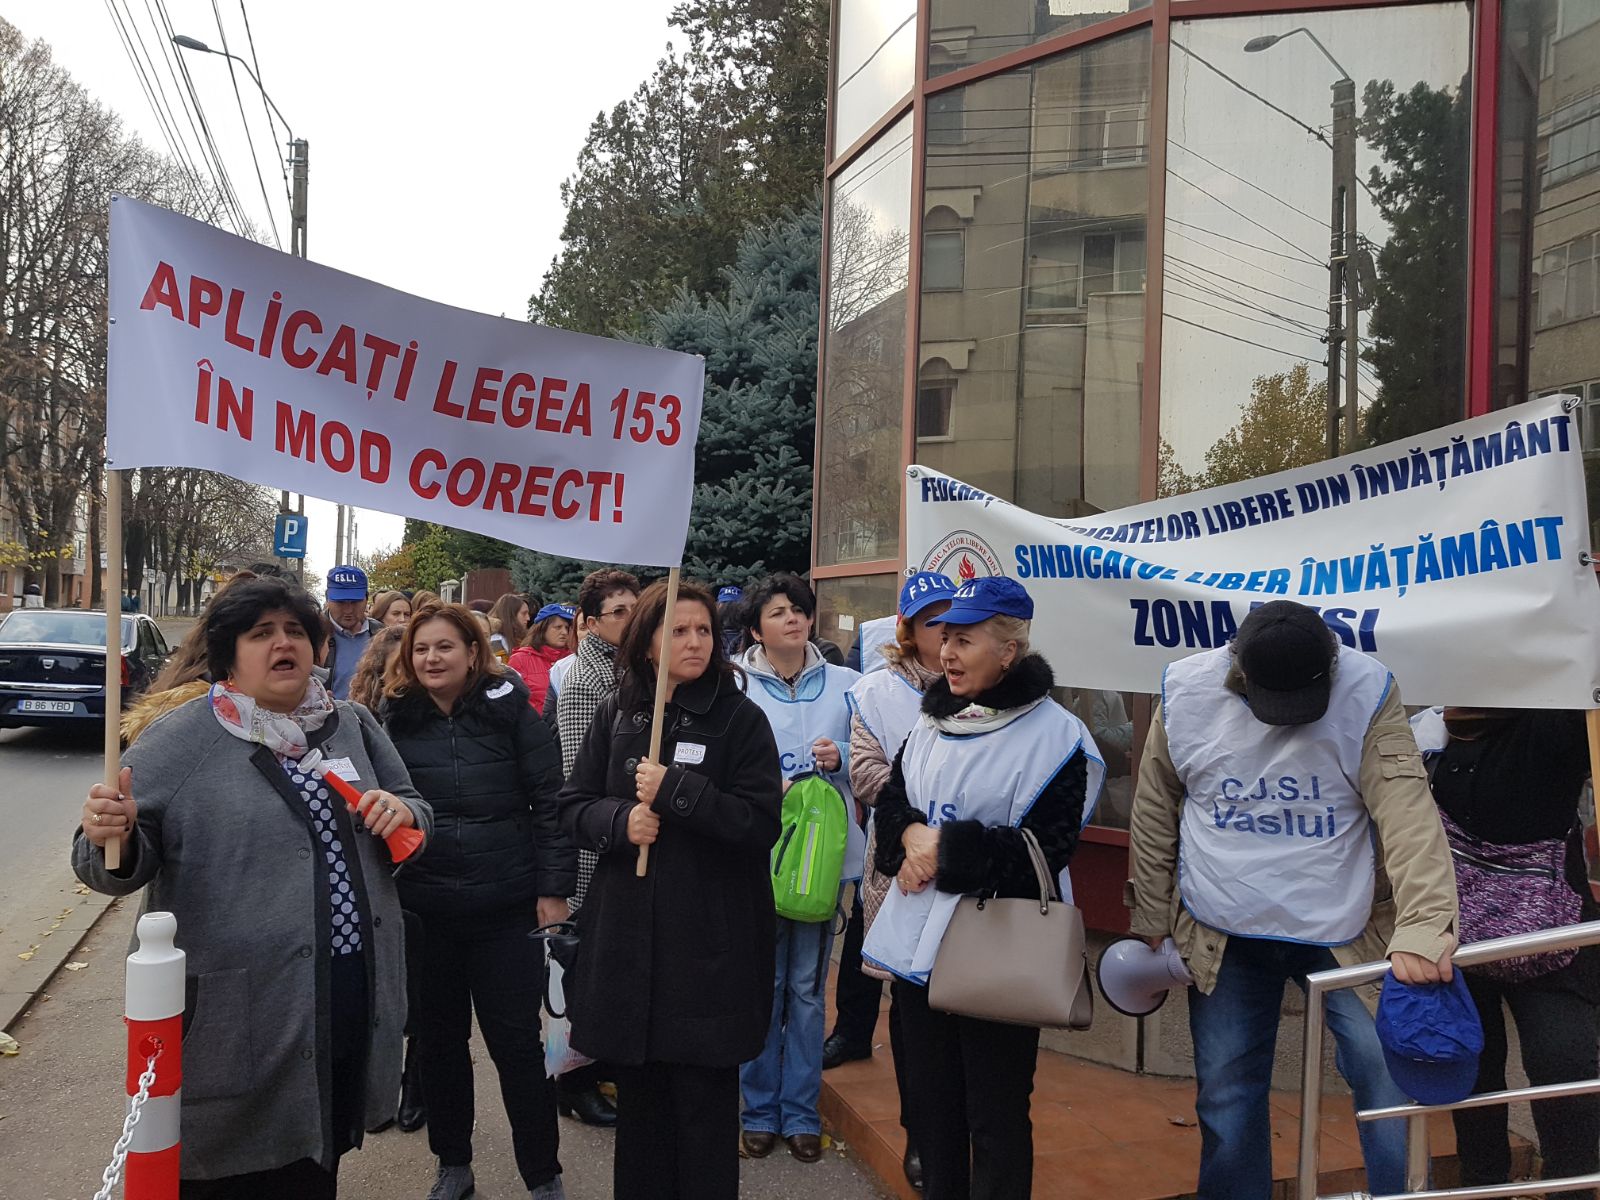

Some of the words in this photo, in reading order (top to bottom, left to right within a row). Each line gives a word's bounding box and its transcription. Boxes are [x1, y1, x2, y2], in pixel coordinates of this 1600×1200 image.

[433, 360, 592, 437] LEGEA
[611, 388, 682, 446] 153
[194, 358, 255, 441] ÎN
[275, 401, 392, 484] MOD
[409, 448, 625, 524] CORECT!
[1202, 488, 1295, 536] LIBERE
[1296, 473, 1350, 515] DIN
[1350, 415, 1571, 501] ÎNVĂȚĂMÂNT
[284, 519, 299, 544] P
[1015, 544, 1179, 580] SINDICATUL
[1184, 567, 1291, 594] LIBER
[1298, 516, 1563, 598] ÎNVĂȚĂMÂNT
[1130, 598, 1238, 649] ZONA
[35, 701, 47, 710] 86
[1213, 800, 1336, 838] Vaslui
